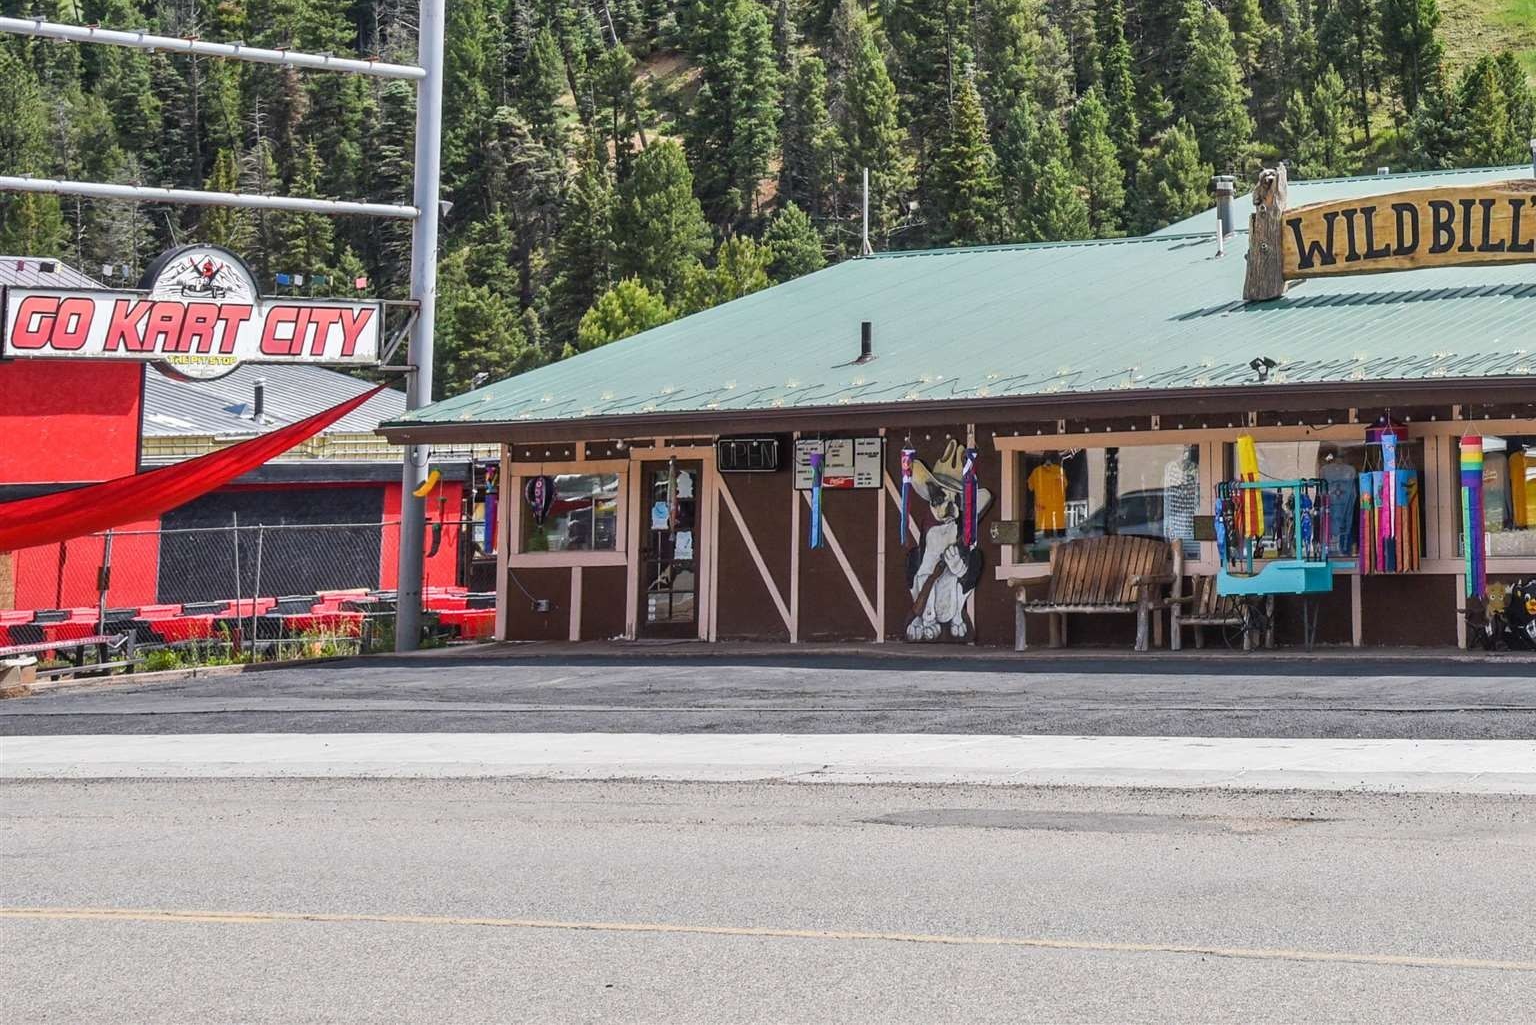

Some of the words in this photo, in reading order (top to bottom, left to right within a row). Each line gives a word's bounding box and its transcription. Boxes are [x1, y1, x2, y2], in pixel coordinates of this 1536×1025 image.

[1286, 202, 1420, 270] WILD
[11, 295, 95, 350] GO
[102, 299, 253, 354] KART
[259, 305, 374, 357] CITY
[168, 355, 189, 365] THE
[191, 355, 208, 365] PIT
[208, 355, 238, 366] STOP
[720, 441, 775, 469] OPEN
